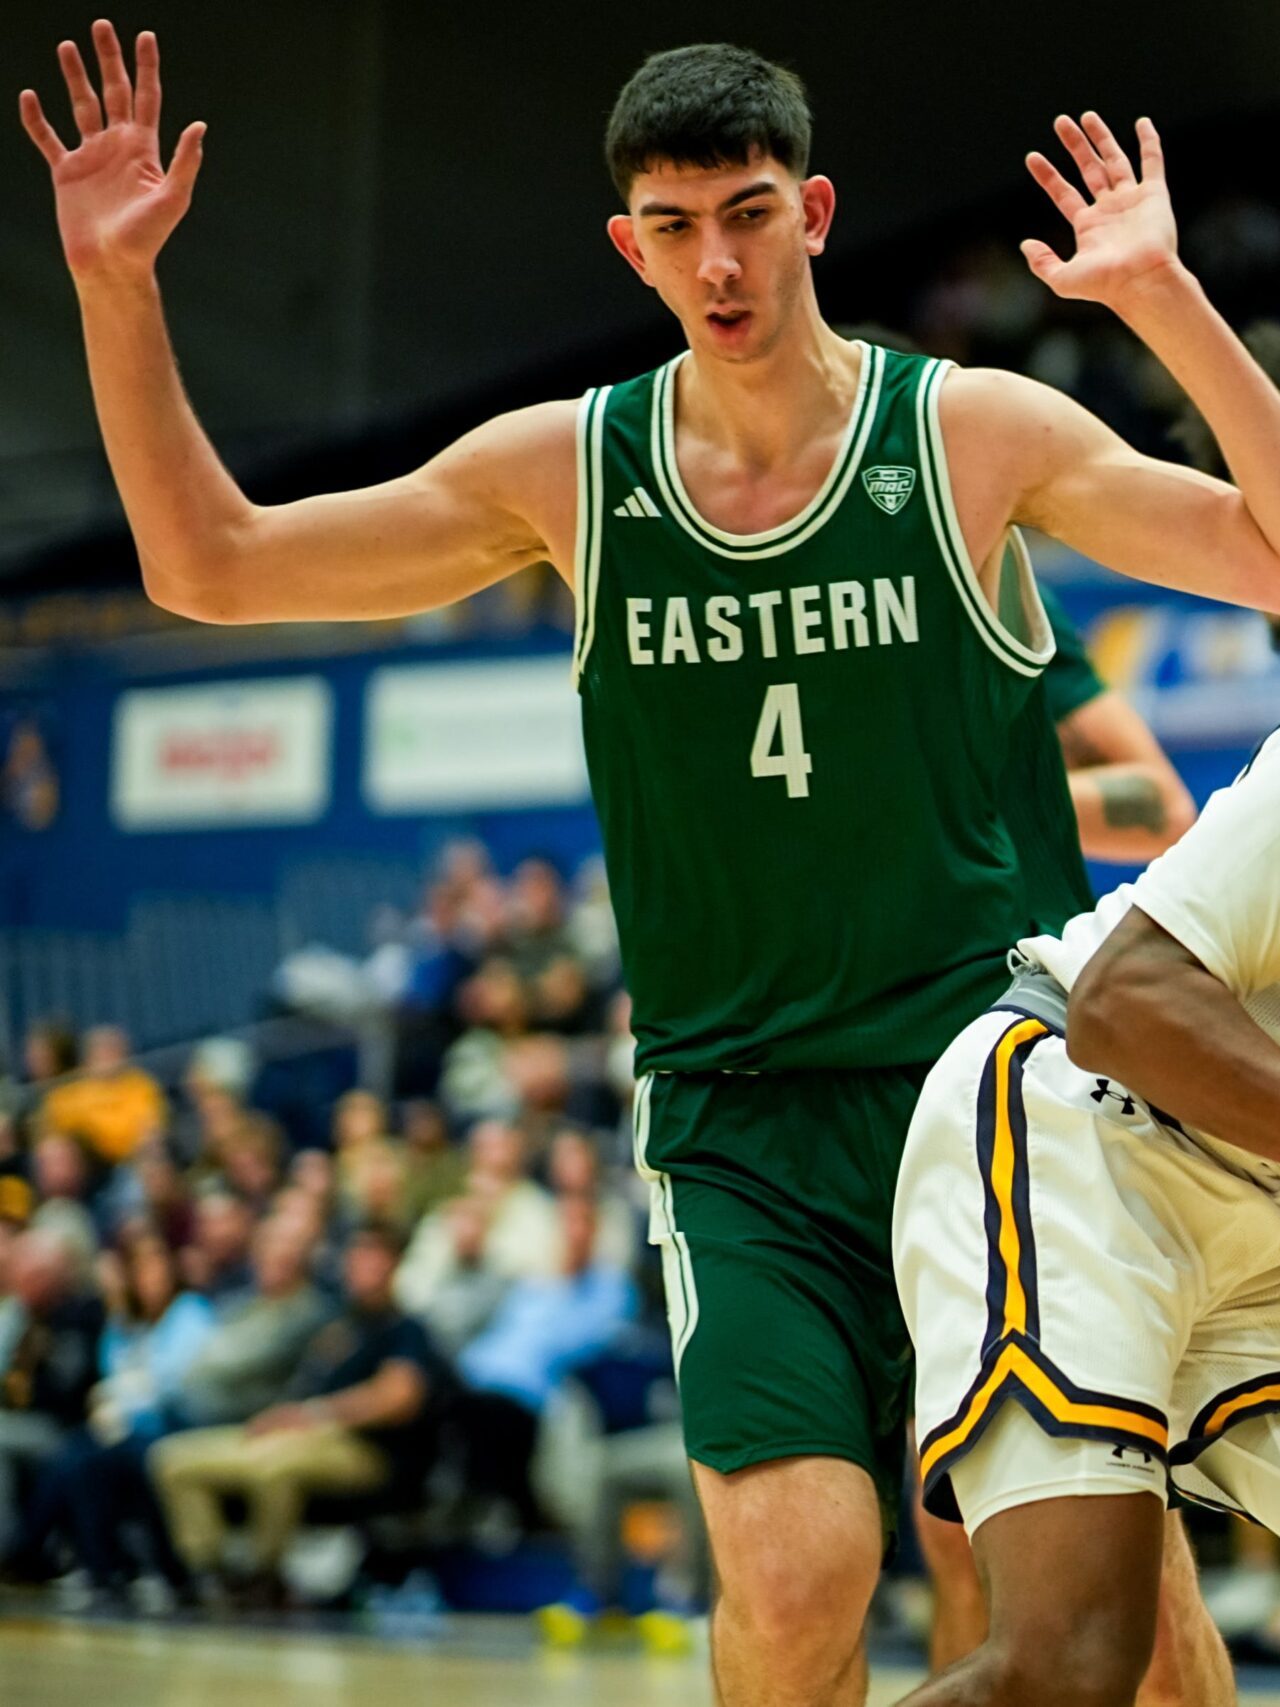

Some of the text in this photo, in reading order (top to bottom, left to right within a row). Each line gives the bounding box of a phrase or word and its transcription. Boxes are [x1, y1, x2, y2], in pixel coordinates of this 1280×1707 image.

[868, 480, 911, 493] MAC
[626, 575, 919, 665] EASTERN
[750, 683, 812, 798] 4
